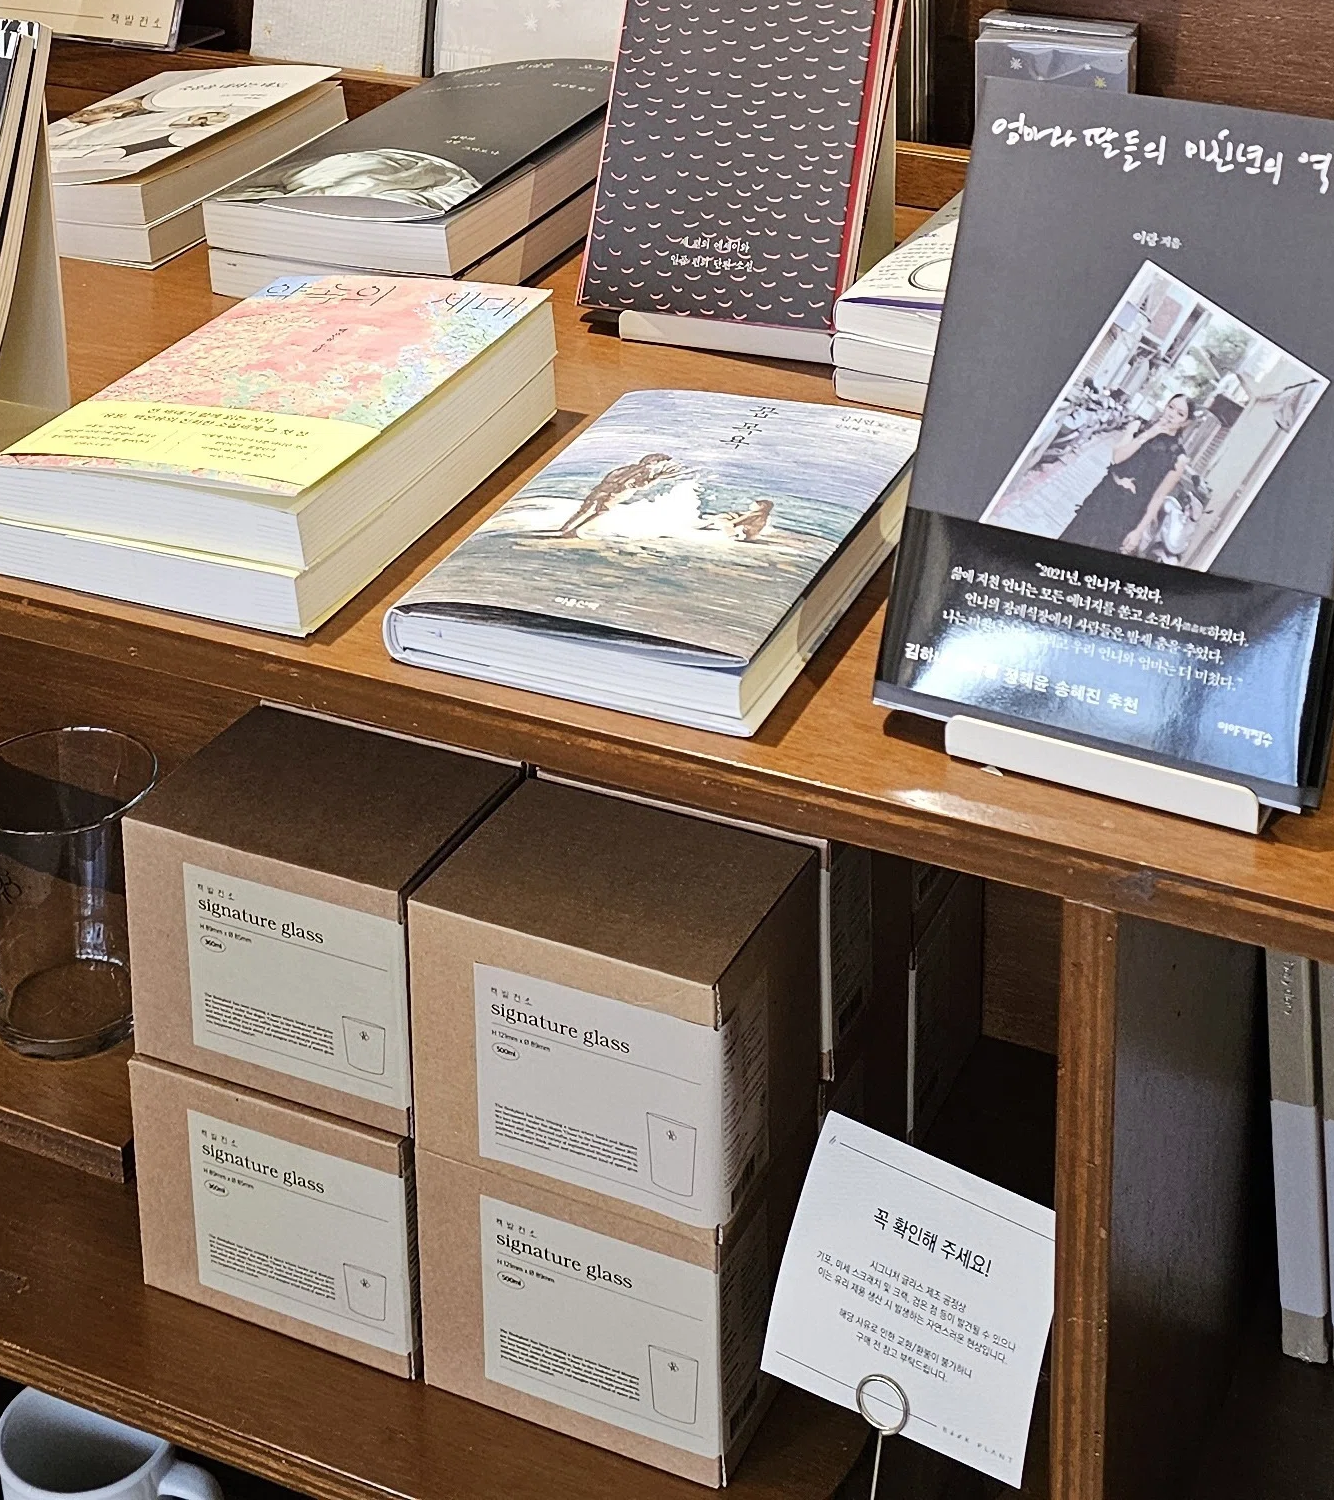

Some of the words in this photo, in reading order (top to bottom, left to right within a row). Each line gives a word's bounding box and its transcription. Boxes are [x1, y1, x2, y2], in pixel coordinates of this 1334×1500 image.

[992, 112, 1076, 148] 엄마와
[1084, 125, 1167, 173] 딸들의
[1185, 129, 1284, 185] 미친년의
[1132, 230, 1158, 248] 이랑
[431, 292, 528, 318] 세대
[952, 566, 973, 583] 삶에
[976, 570, 999, 588] 지친
[1002, 576, 1038, 597] 언니는
[1040, 585, 1065, 604] 모든
[1067, 591, 1116, 616] 에너지를
[1119, 603, 1143, 622] 쏟고
[1084, 574, 1122, 595] 언니가
[1125, 582, 1163, 605] 죽었다.
[964, 592, 1000, 613] 언니의
[1002, 599, 1072, 630] 장례식장에서
[1075, 614, 1123, 642] 사람들은
[1126, 626, 1152, 648] 밤새
[1154, 632, 1179, 653] 춤을
[1182, 638, 1225, 666] 추었다.
[1071, 638, 1096, 657] 우리
[1098, 647, 1135, 669] 언니와
[1137, 656, 1176, 678] 엄마는
[1178, 665, 1192, 681] 더
[1004, 667, 1050, 695] 정혜윤
[1054, 679, 1102, 707] 송혜진
[1106, 692, 1140, 716] 추천
[1216, 720, 1274, 749] 이야기장수
[197, 897, 277, 932] signature
[281, 917, 325, 946] glass
[490, 1000, 579, 1041] signature
[582, 1024, 631, 1055] glass
[201, 1141, 278, 1178] signature
[281, 1166, 325, 1195] glass
[495, 1232, 582, 1273] signature
[586, 1258, 634, 1291] glass
[873, 1207, 890, 1230] 꼭
[892, 1215, 938, 1254] 확인해
[939, 1238, 993, 1279] 주세요!
[817, 1251, 833, 1267] 기포,
[835, 1259, 850, 1274] 미세
[852, 1268, 882, 1290] 스크래치
[993, 1334, 1017, 1353] 있으나
[869, 1260, 901, 1281] 시그니처
[902, 1274, 923, 1293] 글라스
[926, 1286, 941, 1300] 제조
[943, 1296, 966, 1313] 공정상
[926, 1318, 965, 1344] 자연스러운
